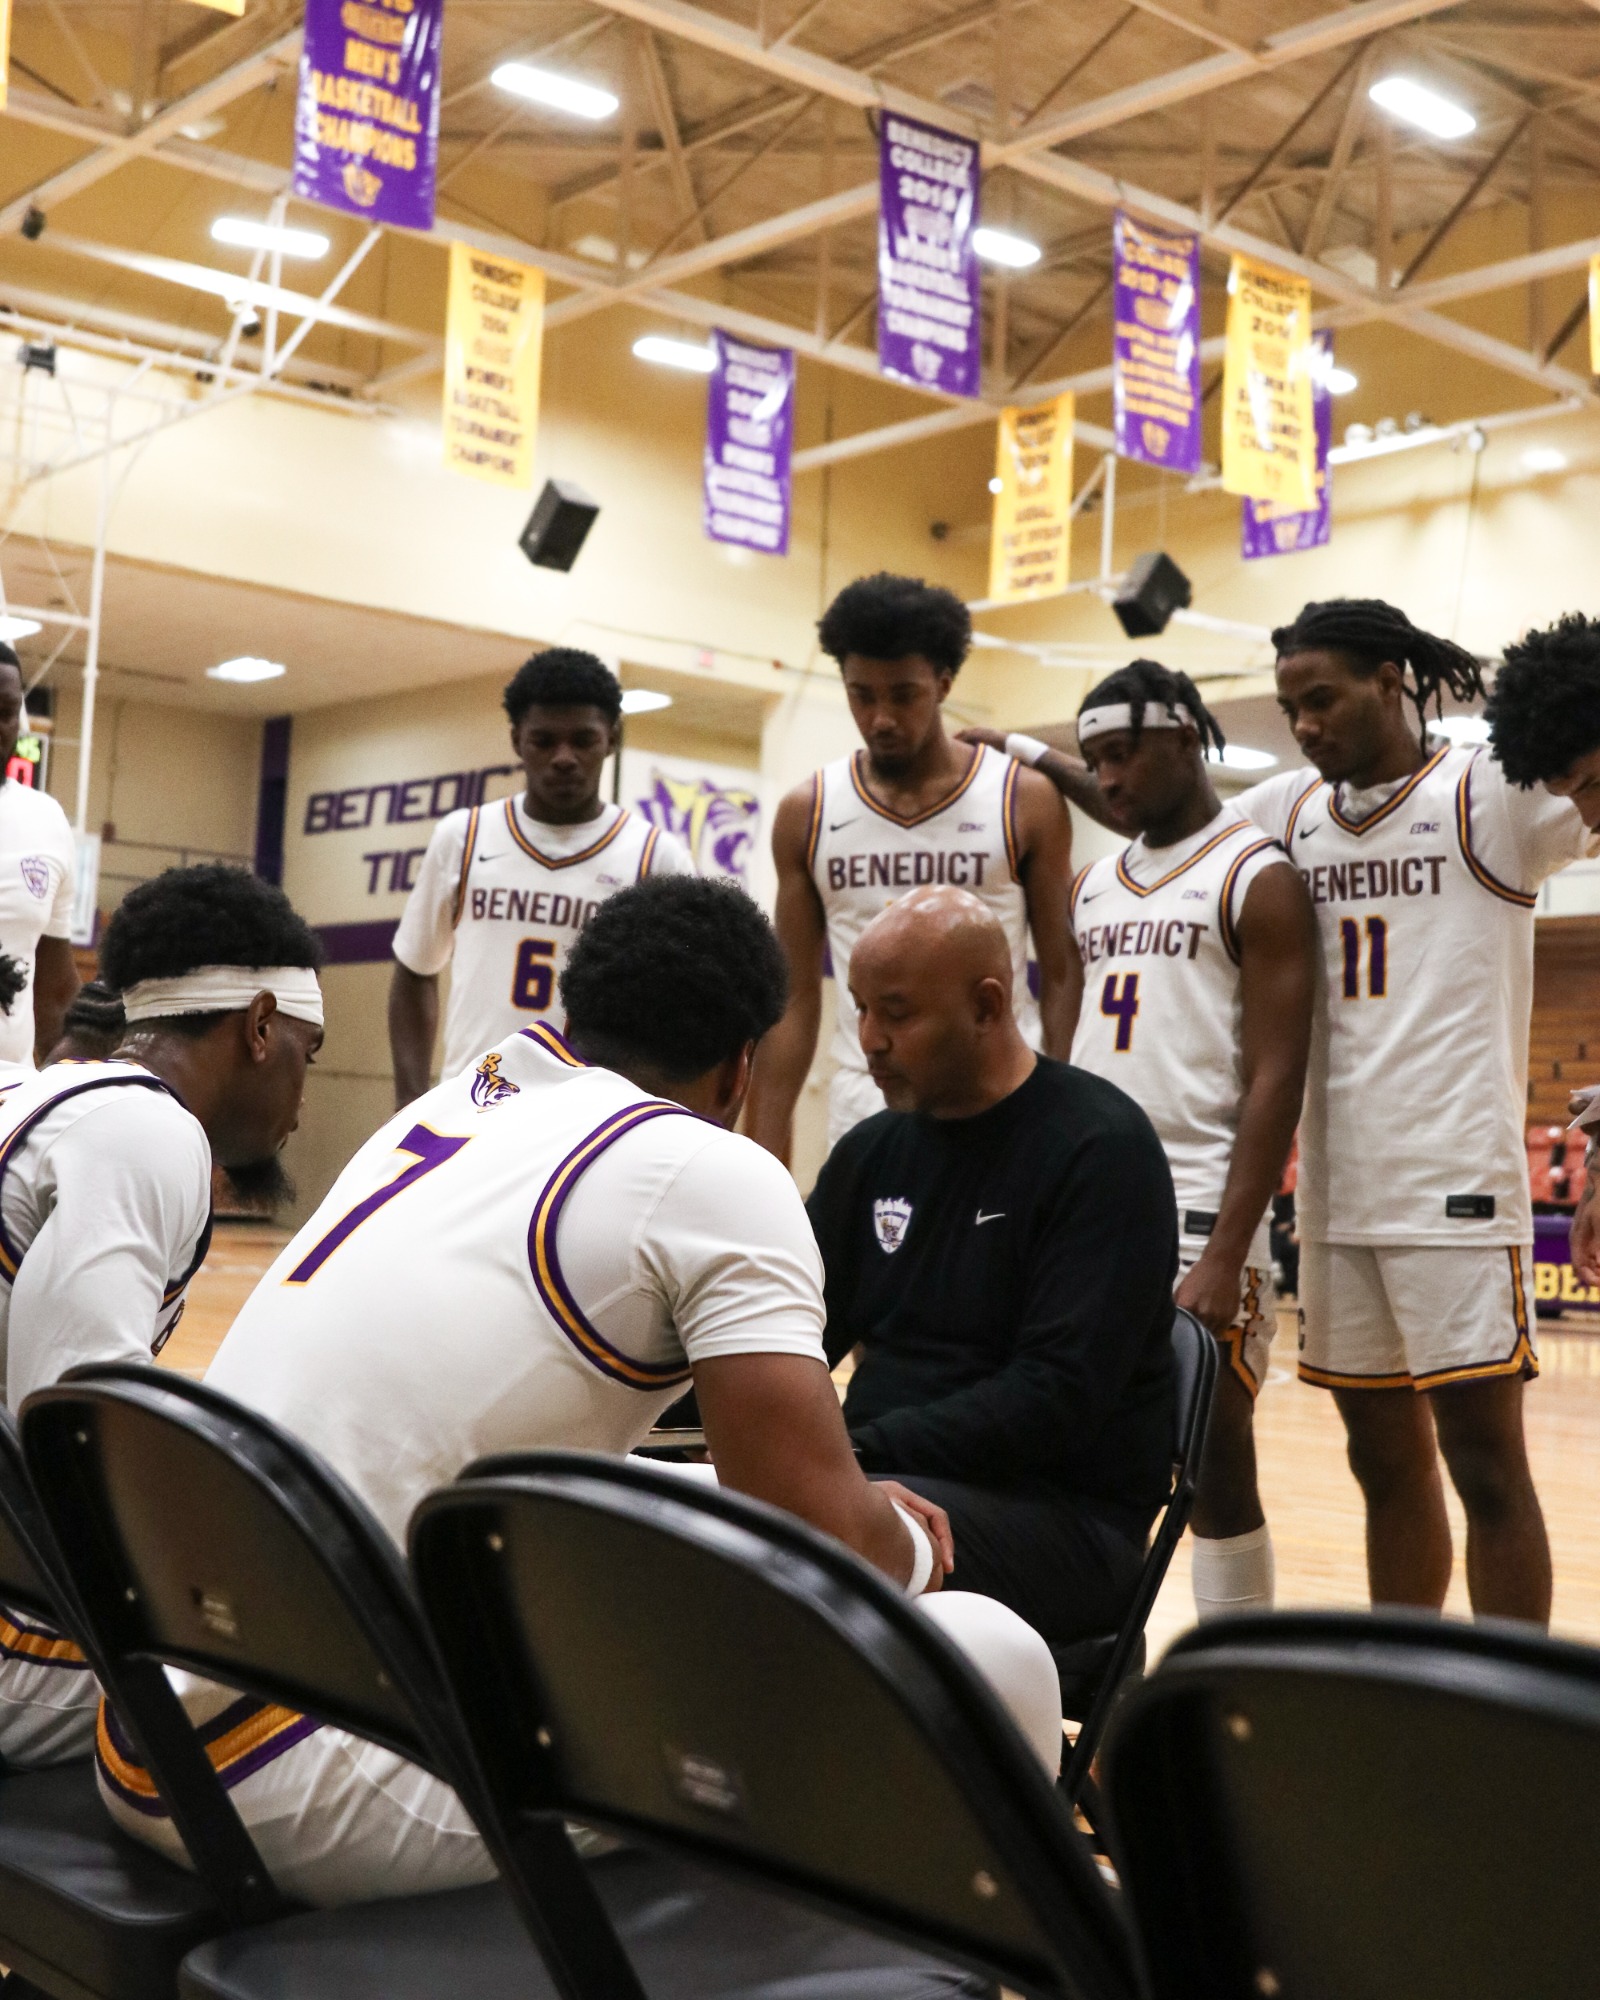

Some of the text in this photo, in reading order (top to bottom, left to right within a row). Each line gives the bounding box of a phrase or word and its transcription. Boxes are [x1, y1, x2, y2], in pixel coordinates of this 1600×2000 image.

[827, 851, 990, 892] BENEDICT
[510, 936, 557, 1012] 6
[1339, 915, 1388, 1000] 11
[1099, 971, 1142, 1054] 4
[280, 1120, 478, 1288] 7
